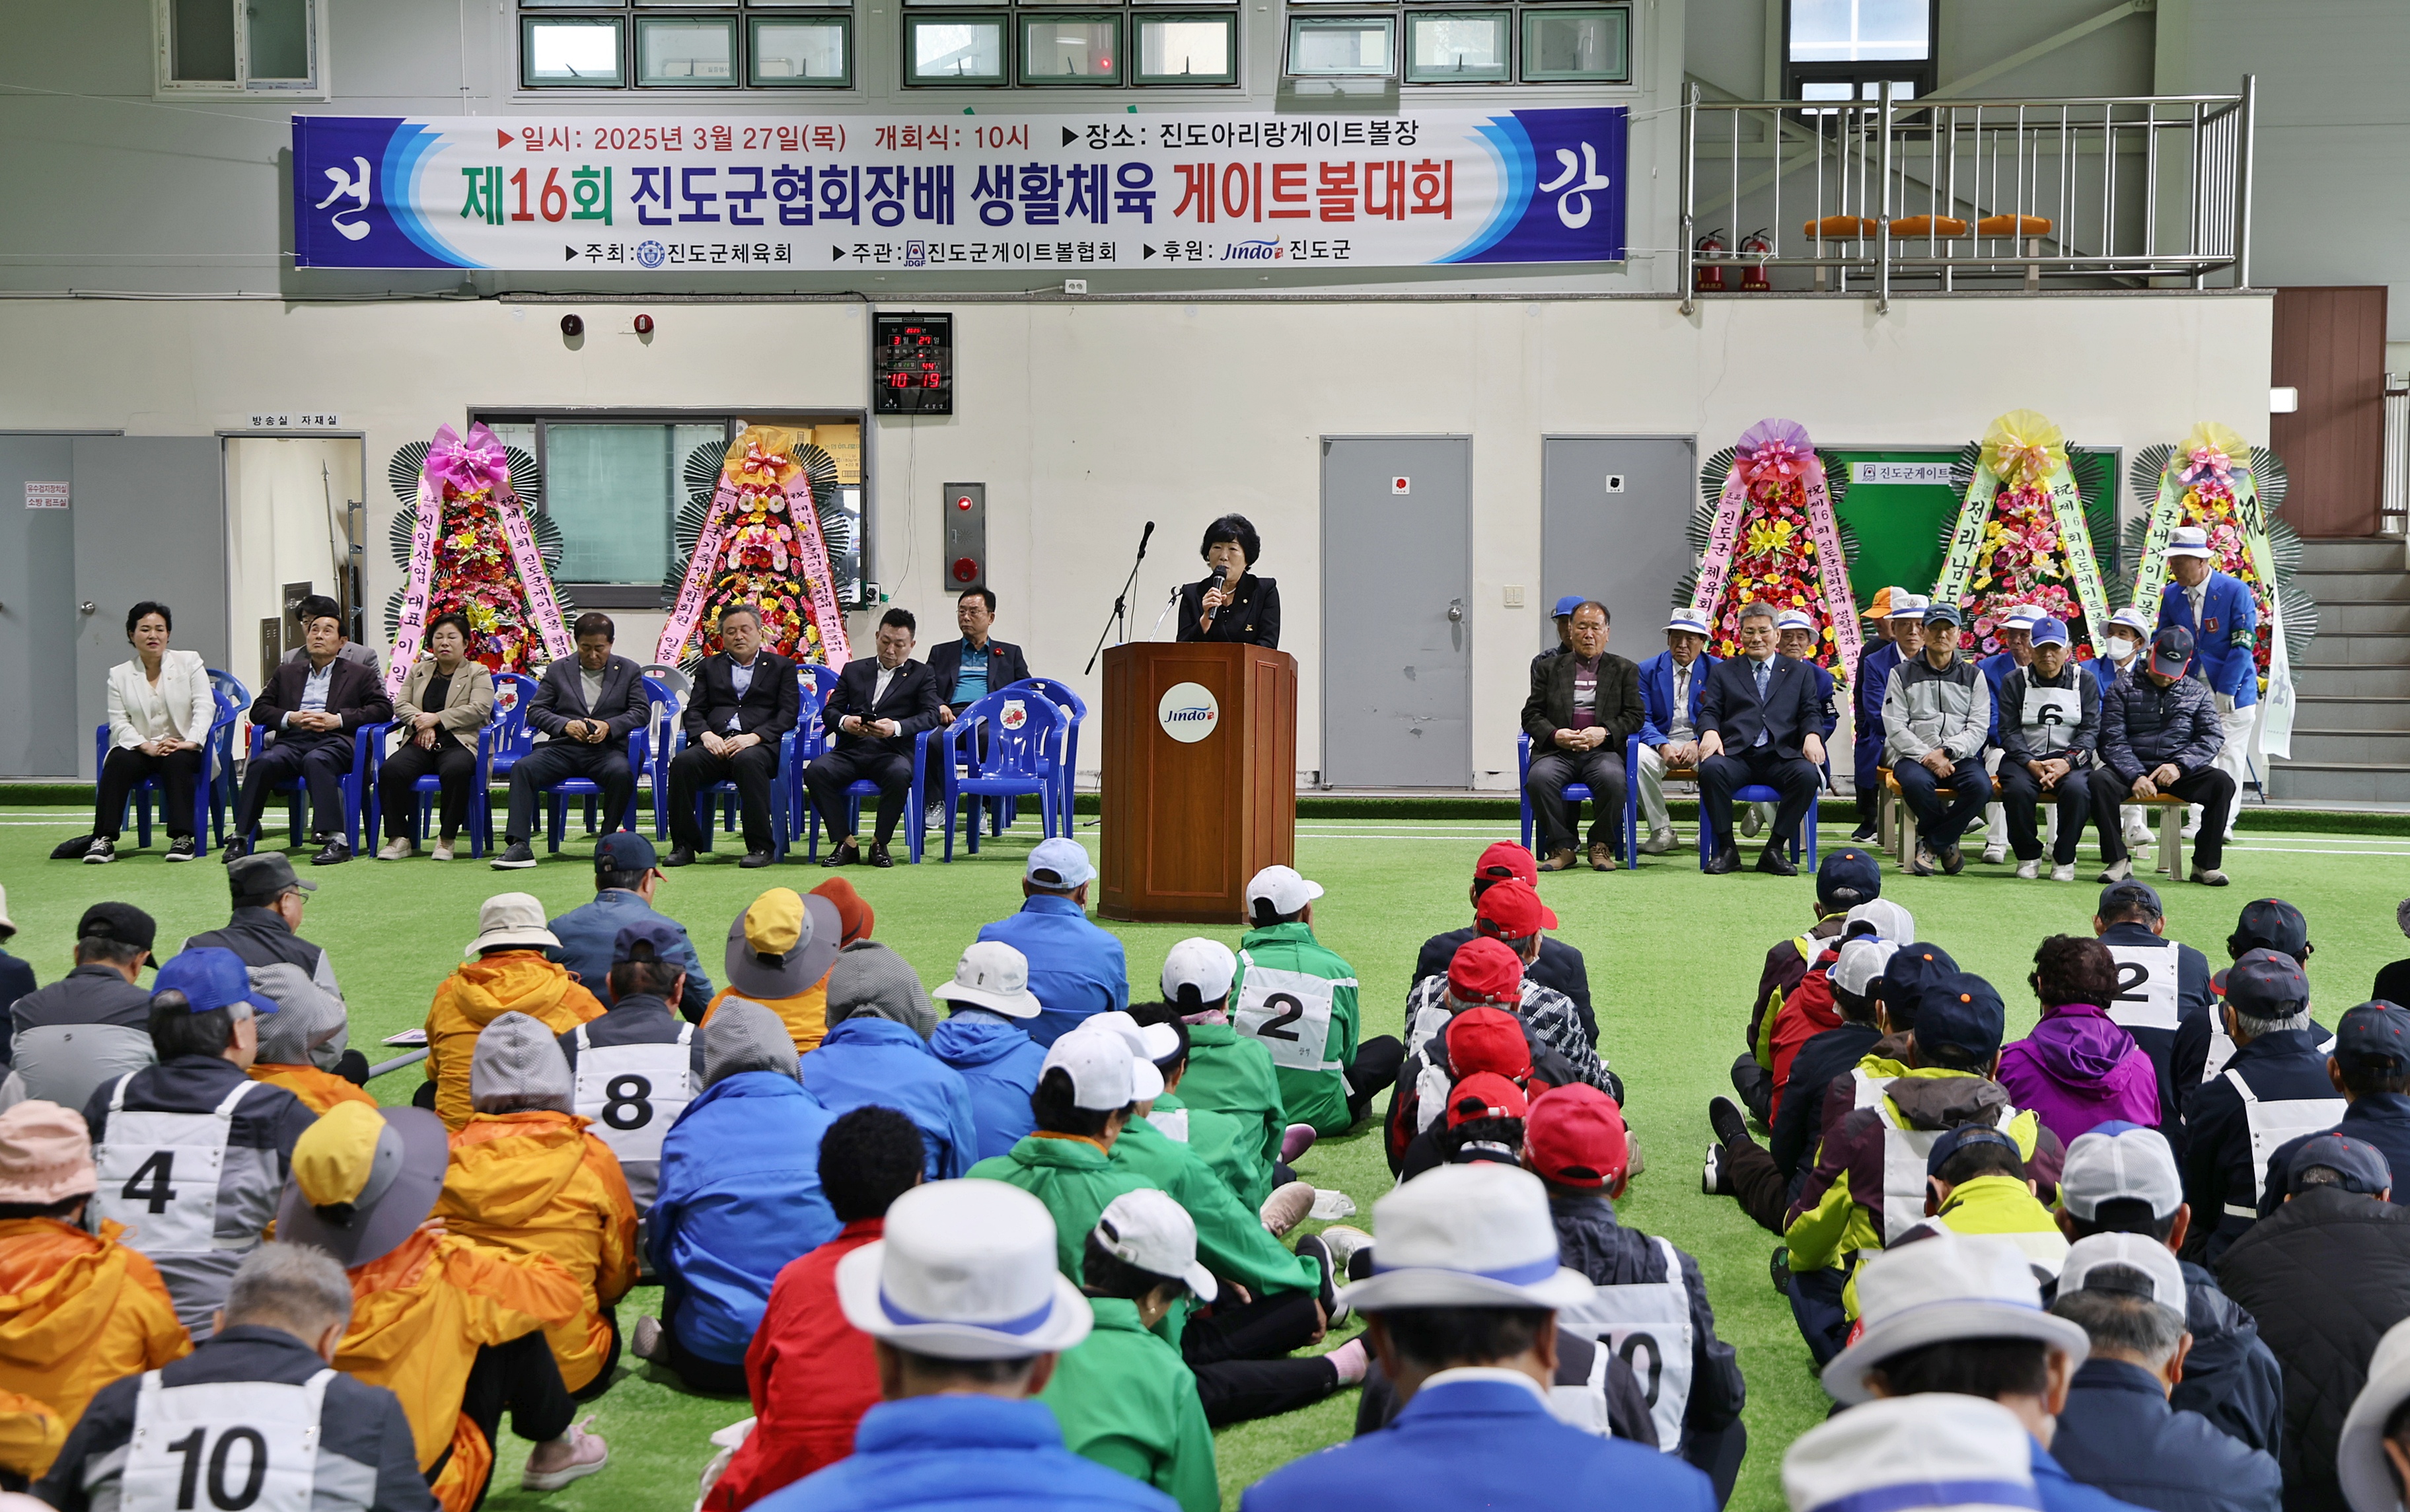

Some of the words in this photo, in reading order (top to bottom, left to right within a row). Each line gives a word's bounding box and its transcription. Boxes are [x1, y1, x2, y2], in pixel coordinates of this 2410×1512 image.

[522, 126, 582, 152] 일시:
[595, 126, 683, 151] 2025년
[694, 126, 733, 152] 3월
[743, 124, 846, 153] 27일(목)
[875, 126, 961, 151] 개회식:
[974, 124, 1029, 151] 10시
[1086, 124, 1147, 150] 장소:
[1160, 120, 1419, 149] 진도아리랑게이트볼장
[316, 157, 372, 241] 건
[460, 165, 613, 226] 제16회
[630, 164, 955, 227] 진도군협회장배
[970, 162, 1156, 227] 생활체육
[1173, 159, 1453, 224] 게이트볼대회
[1539, 141, 1610, 229] 강
[585, 243, 635, 264] 주최:
[667, 243, 791, 264] 진도군체육회
[852, 243, 902, 264] 주관:
[928, 242, 1116, 263] 진도군게이트볼협회
[1163, 241, 1214, 262] 후원:
[1221, 244, 1272, 260] Jindo
[1290, 240, 1352, 260] 진도군
[894, 336, 900, 345] 3
[918, 336, 931, 345] 27
[892, 373, 908, 387] 10
[924, 373, 940, 388] 19
[252, 415, 287, 426] 방송실
[301, 415, 337, 425] 자재실
[1880, 466, 1959, 480] 진도군게이트
[505, 507, 530, 549] 제16회
[1711, 510, 1735, 557] 진도군
[1808, 499, 1829, 536] 제16회
[2057, 500, 2082, 544] 제16회
[414, 513, 433, 584] 신일산업
[1938, 499, 1986, 606] 전라남도
[1697, 565, 1720, 612] 체육회
[404, 593, 424, 628] 대표
[1164, 710, 1206, 723] Jindo
[2037, 704, 2063, 725] 6
[2116, 962, 2149, 1003] 2
[1257, 993, 1303, 1042] 2
[602, 1075, 653, 1130] 8
[122, 1151, 176, 1214] 4
[1596, 1332, 1662, 1409] 0
[167, 1426, 268, 1511] 10
